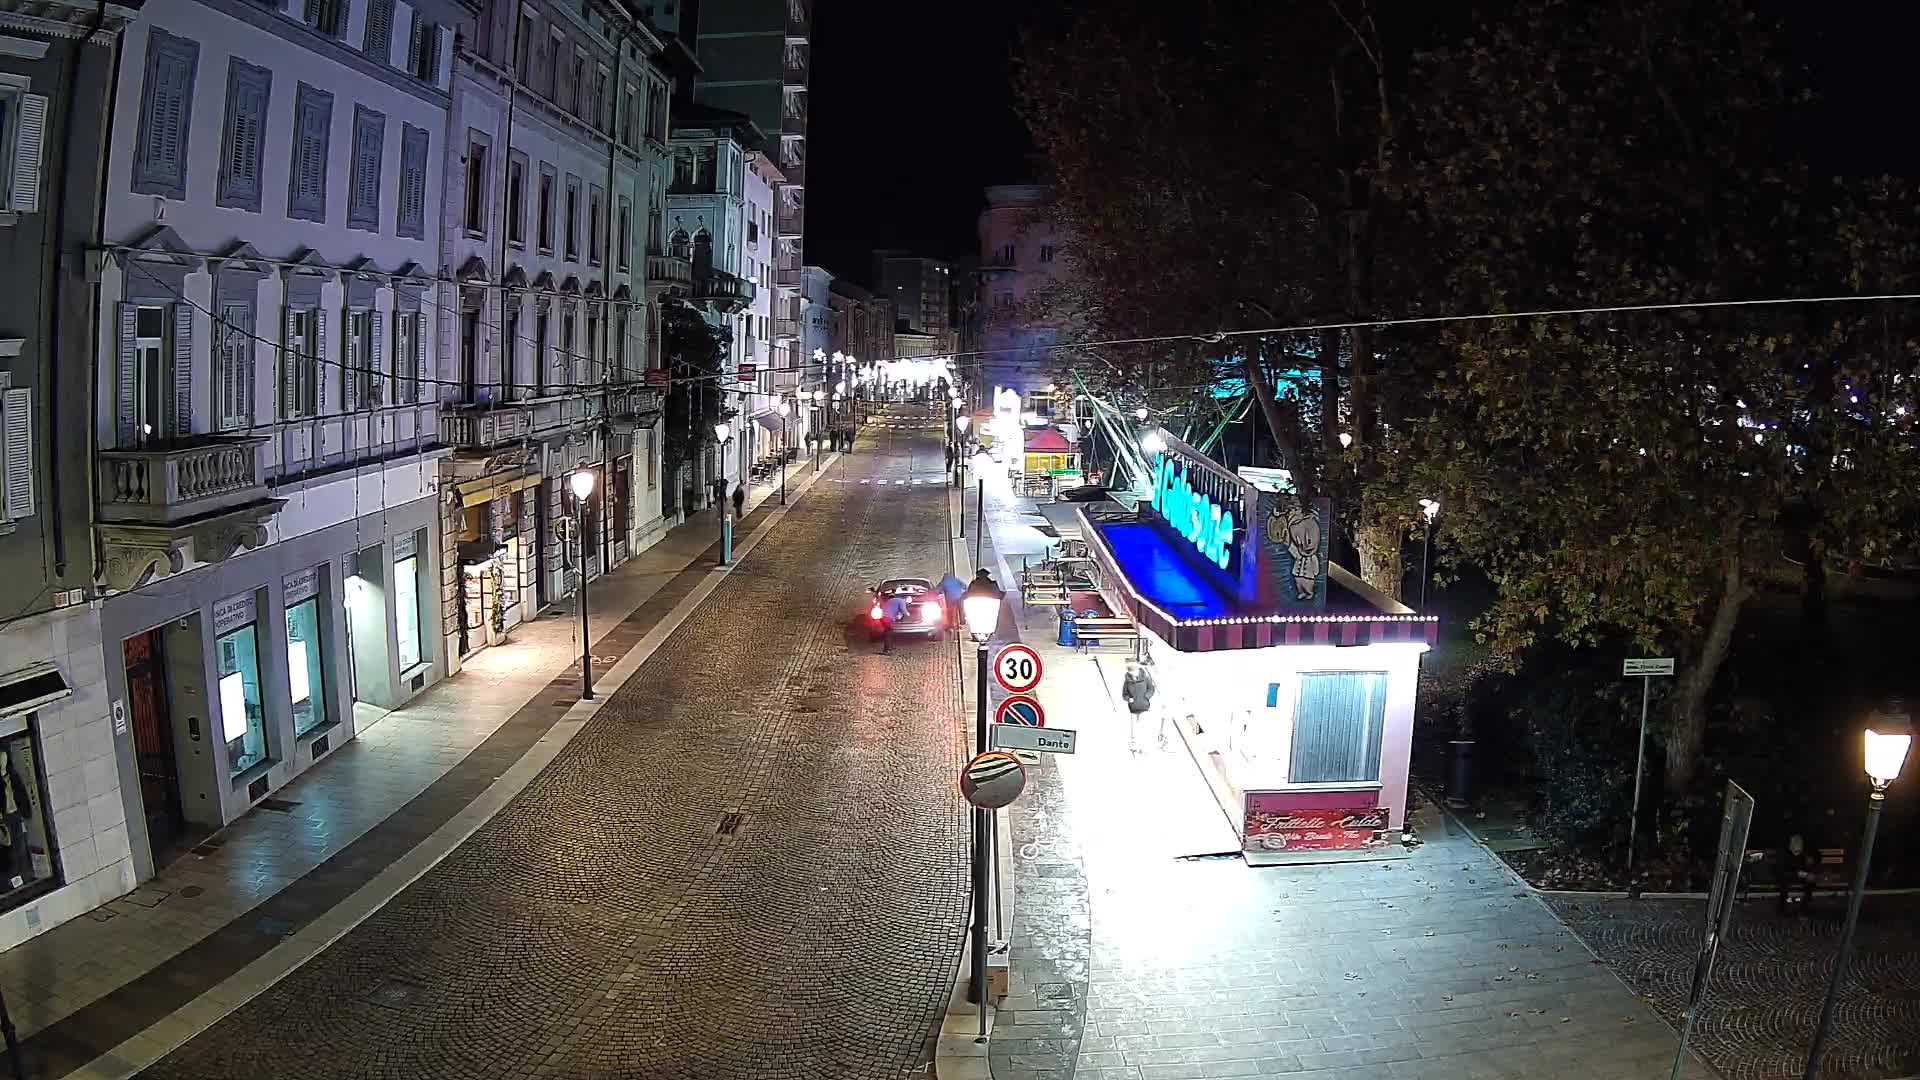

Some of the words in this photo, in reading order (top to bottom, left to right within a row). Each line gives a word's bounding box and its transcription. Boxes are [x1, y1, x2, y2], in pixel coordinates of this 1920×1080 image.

[215, 611, 244, 627] OPERATIVO
[1006, 658, 1032, 680] 30
[1038, 737, 1070, 749] Dante
